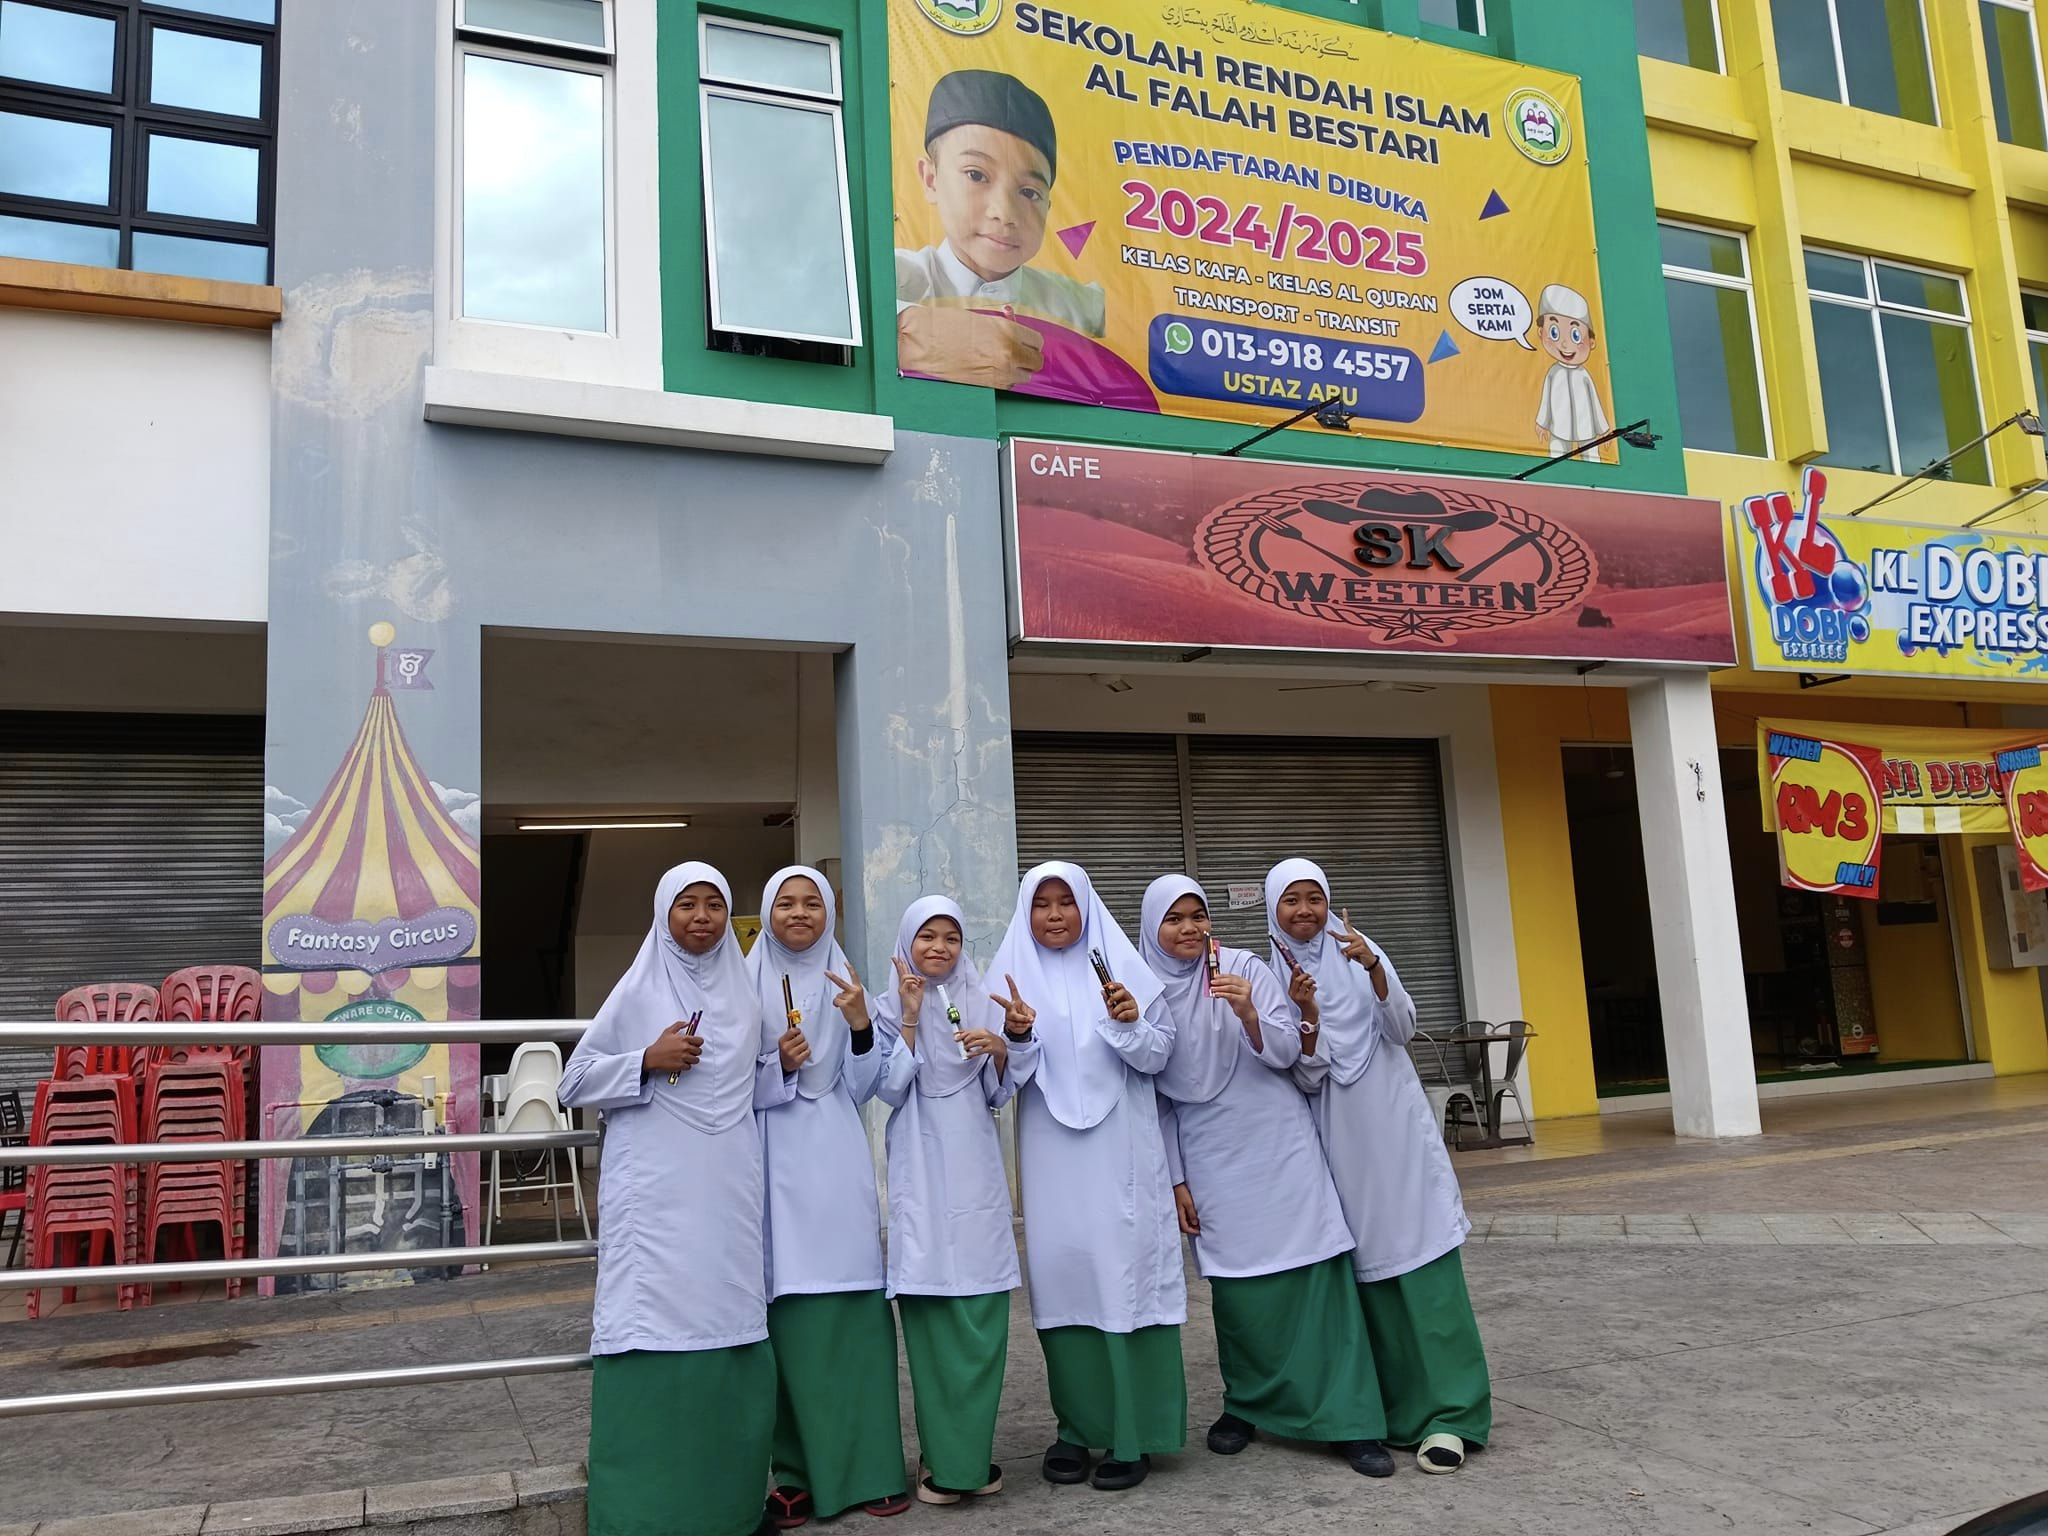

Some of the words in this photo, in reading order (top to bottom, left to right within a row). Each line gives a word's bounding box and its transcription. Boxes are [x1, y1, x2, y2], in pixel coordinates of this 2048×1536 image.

[1015, 2, 1203, 78] SEKOLAH
[1215, 55, 1374, 114] RENDAH
[1384, 91, 1490, 138] ISLAM
[1085, 63, 1138, 102] AL
[1149, 78, 1277, 133] FALAH
[1288, 109, 1439, 164] BESTARI
[1113, 141, 1320, 190] PENDAFTARAN
[1327, 174, 1430, 222] DIBUKA
[1121, 180, 1427, 277] 2024/2025
[1122, 246, 1190, 273] KELAS
[1195, 260, 1251, 285] KAFA
[1268, 272, 1331, 297] KELAS
[1337, 284, 1363, 303] AL
[1366, 289, 1437, 313] QURAN
[1473, 288, 1504, 300] JOM
[1174, 286, 1299, 324] TRANSPORT
[1315, 311, 1400, 337] TRANSIT
[1468, 303, 1515, 316] SERTAI
[1477, 319, 1512, 332] KAMI
[1201, 328, 1324, 371] 013-918
[1333, 347, 1410, 382] 4557
[1223, 371, 1302, 400] USTAZ
[1030, 453, 1101, 479] CAFE
[1353, 522, 1464, 572] SK
[1745, 466, 1837, 604] KL
[1871, 548, 1919, 592] KL
[1769, 732, 1822, 762] WASHER
[1835, 862, 1877, 888] ONLY!
[287, 927, 381, 955] Fantasy
[389, 923, 459, 949] Circus
[376, 1006, 393, 1015] OF
